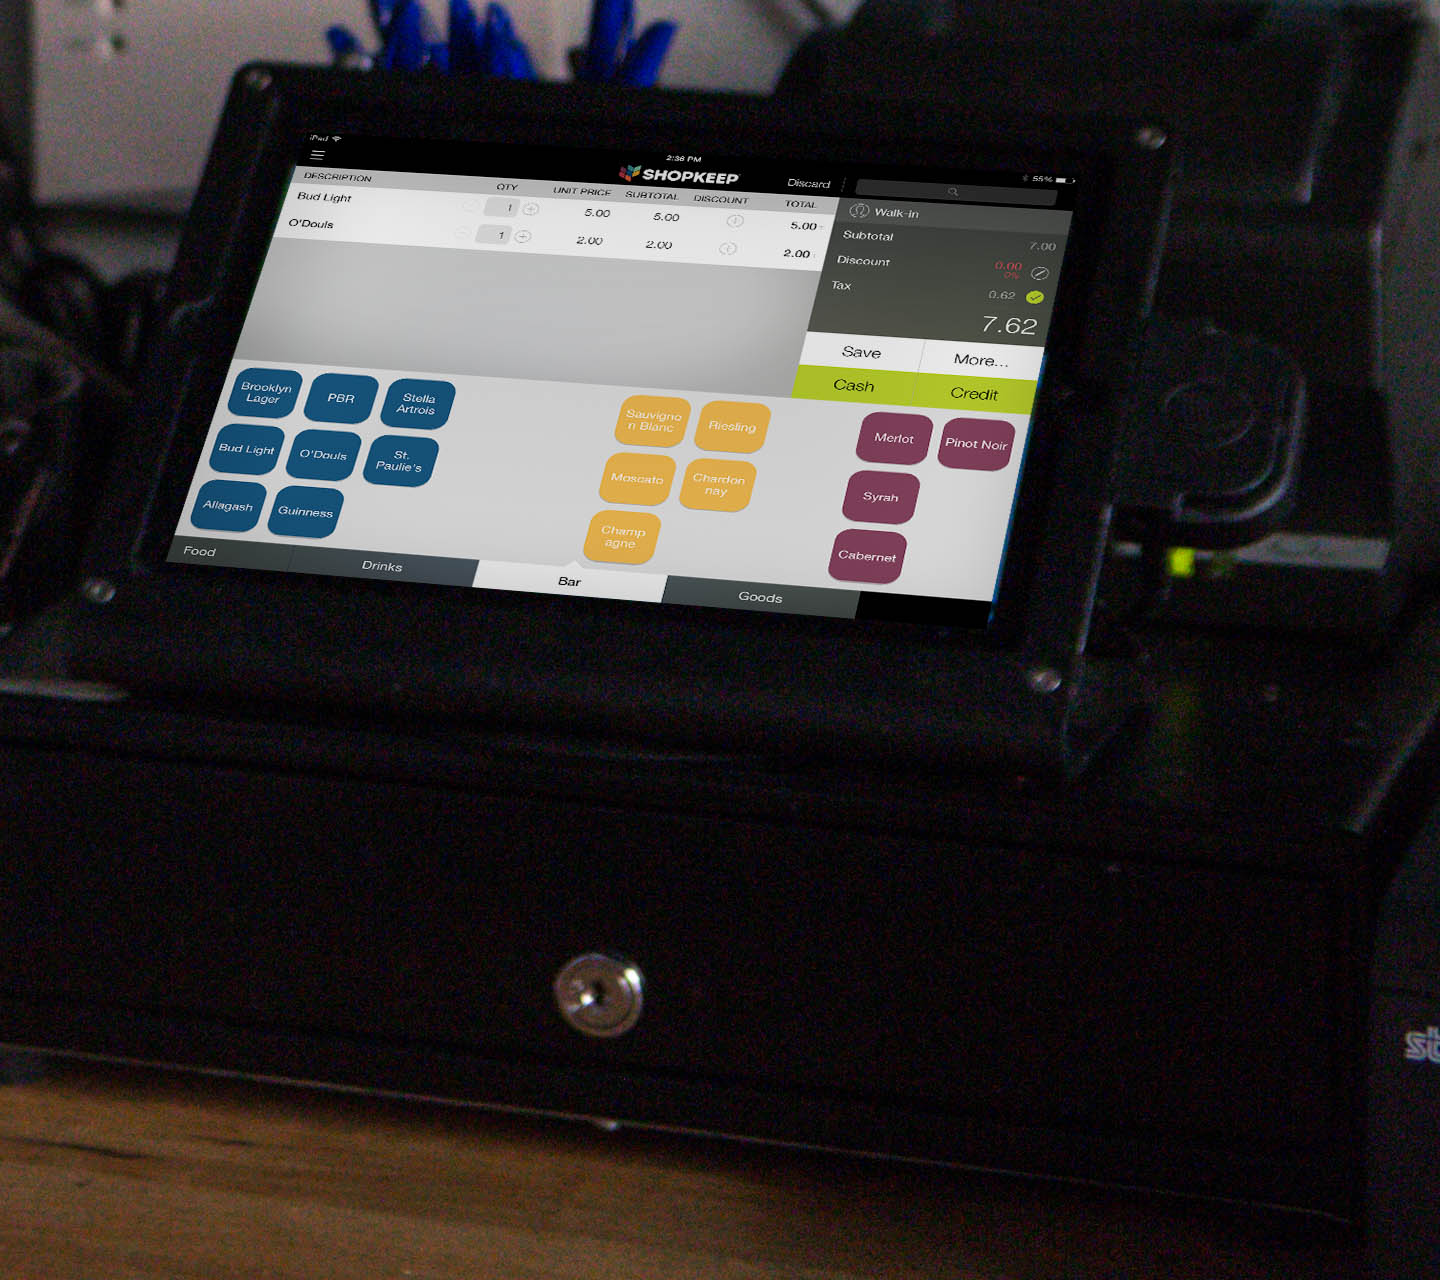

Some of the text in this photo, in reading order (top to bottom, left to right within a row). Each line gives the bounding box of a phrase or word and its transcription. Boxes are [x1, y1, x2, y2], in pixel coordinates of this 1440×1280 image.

[309, 134, 329, 142] iPad
[303, 171, 372, 183] DESCRIPTION
[642, 168, 739, 185] SHOPKEEP
[496, 183, 518, 192] QTY
[787, 178, 831, 189] Discard
[297, 191, 352, 204] Bud Light
[553, 186, 612, 197] UNIT PRICE
[625, 190, 679, 201] SUBTOTAL
[694, 194, 749, 205] DISCOUNT
[785, 200, 817, 209] TOTAL
[584, 208, 611, 218] 5.00
[653, 212, 680, 222] 5.00
[874, 207, 919, 219] Walk-in
[288, 218, 334, 229] O'Douls
[790, 221, 818, 231] 5.00
[576, 236, 603, 246] 2.00
[843, 230, 894, 242] Subtotal
[645, 240, 673, 250] 2.00
[1029, 242, 1057, 251] 7.00
[783, 249, 810, 258] 2.00
[837, 255, 890, 267] Discount
[995, 261, 1022, 271] 0.00
[831, 280, 852, 291] Tax
[988, 290, 1016, 300] 0.62
[983, 315, 1038, 335] 7.62
[842, 345, 882, 359] Save
[954, 353, 1008, 368] More...
[241, 381, 292, 394] Brooklyn
[833, 378, 875, 393] Cash
[246, 393, 281, 406] Lager
[327, 393, 355, 404] PBR
[402, 393, 436, 404] Stella
[950, 386, 999, 402] Credit
[396, 404, 435, 416] Artrois
[625, 409, 683, 422] Sauvigno
[640, 422, 674, 433] Blanc
[708, 420, 757, 434] Riesling
[874, 432, 914, 444] Merlot
[945, 437, 1009, 451] Pinot Noir
[218, 443, 275, 456] Bud Light
[299, 449, 348, 461] O'Douls
[393, 450, 410, 460] St.
[375, 461, 422, 473] Paulie's
[611, 472, 664, 485] Moscato
[692, 473, 745, 485] Chardon
[705, 486, 728, 498] nay
[863, 491, 899, 504] Syrah
[202, 500, 254, 513] Allagash
[278, 506, 333, 519] Guinness
[601, 525, 647, 538] Champ
[604, 539, 636, 550] agne
[183, 545, 217, 558] Food
[838, 550, 897, 563] Cabernet
[361, 559, 404, 573] Drinks
[558, 575, 582, 588] Bar
[738, 591, 784, 605] Goods
